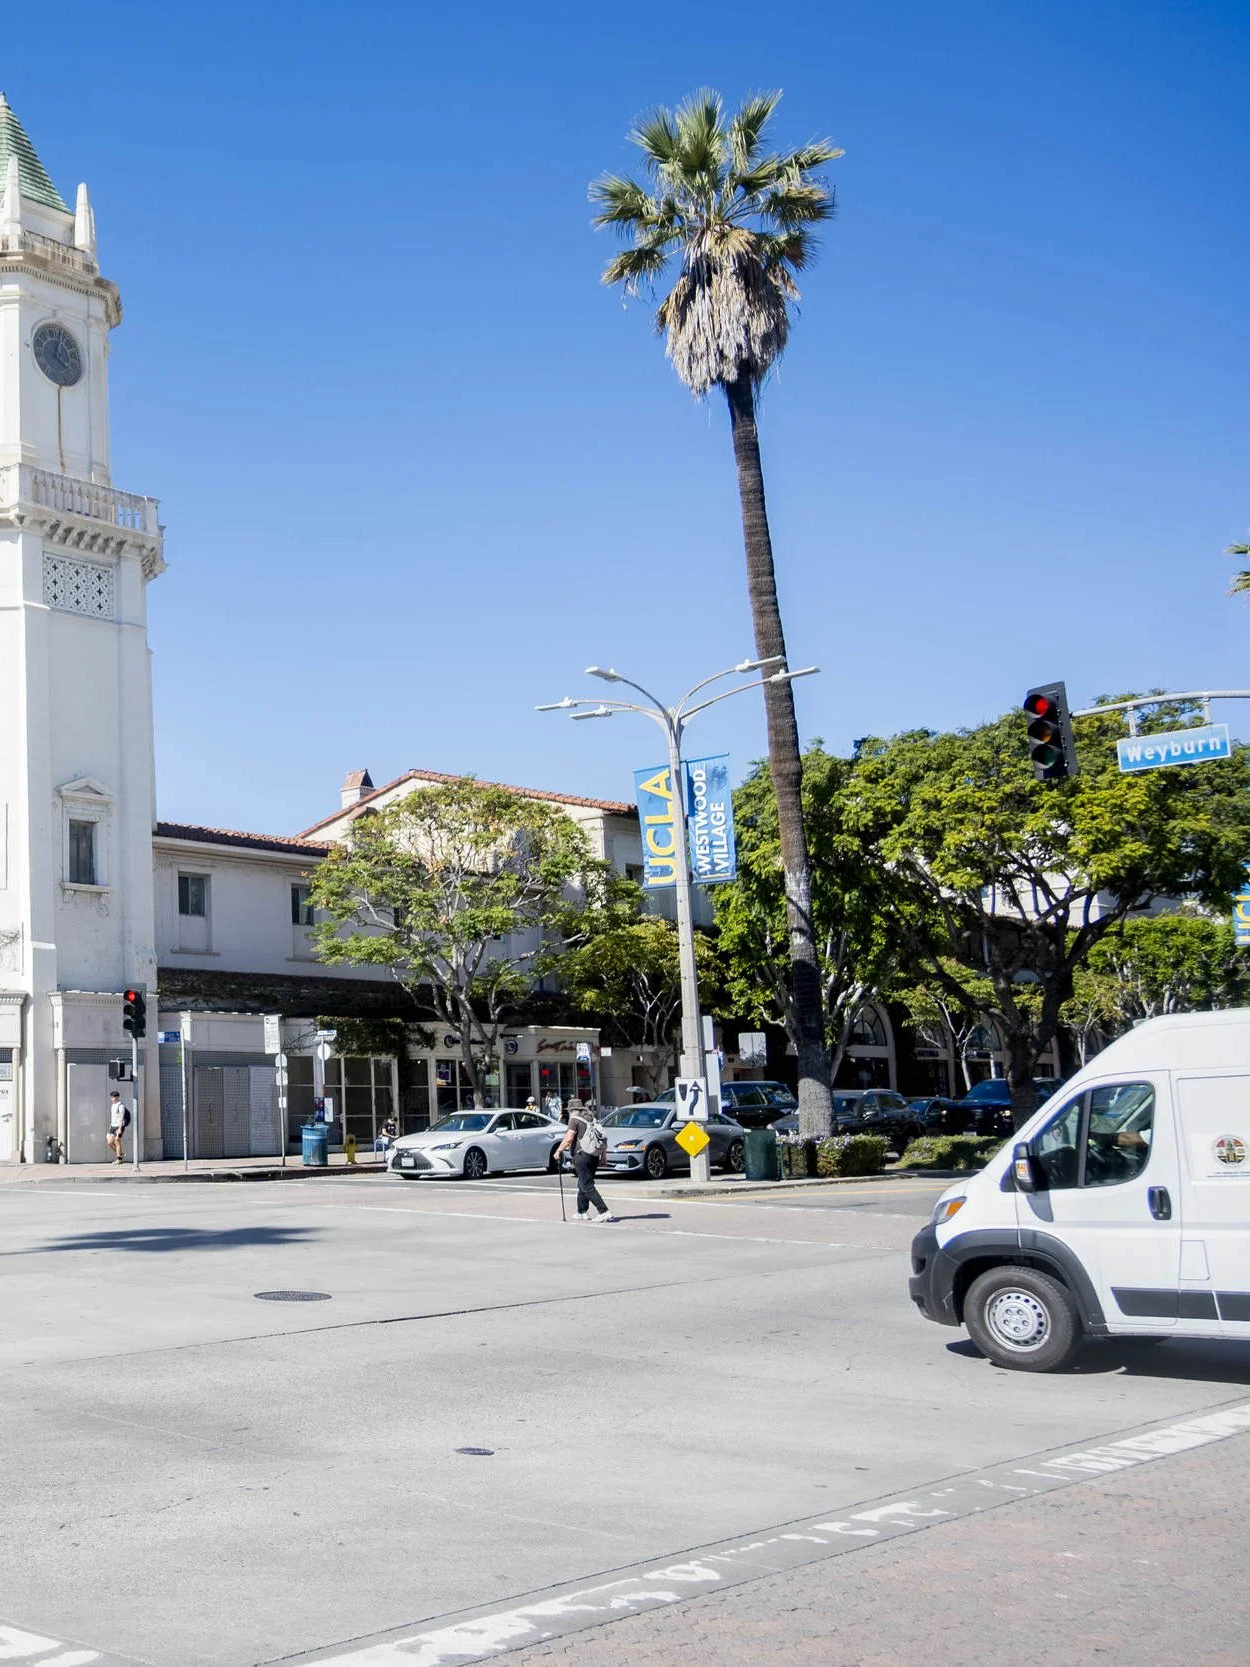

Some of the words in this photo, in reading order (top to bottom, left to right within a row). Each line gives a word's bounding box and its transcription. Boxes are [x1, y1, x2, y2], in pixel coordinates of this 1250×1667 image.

[1126, 737, 1222, 763] Weyburn
[638, 768, 678, 885] UCLA
[692, 769, 712, 874] WESTWOOD
[709, 802, 731, 872] VILLAGE
